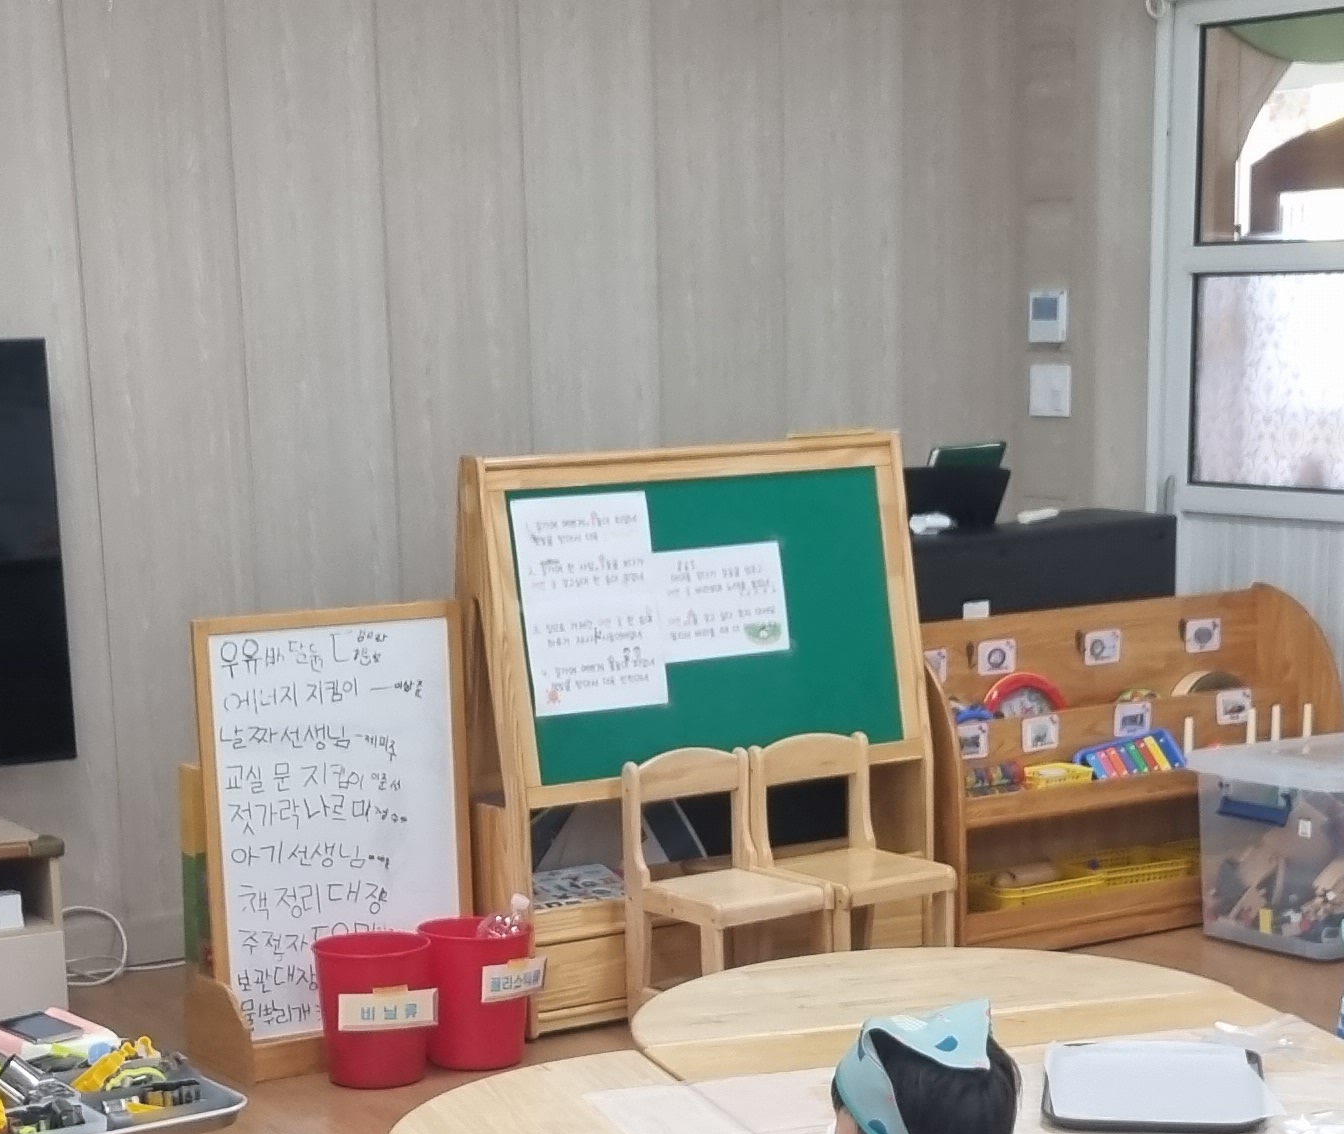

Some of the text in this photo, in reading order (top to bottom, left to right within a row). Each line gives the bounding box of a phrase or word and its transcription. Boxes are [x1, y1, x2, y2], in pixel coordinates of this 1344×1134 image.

[223, 682, 298, 714] 에너지
[306, 677, 358, 704] 지킴이
[225, 764, 265, 794] 교실
[273, 762, 291, 792] 문
[300, 761, 365, 790] 지킴이
